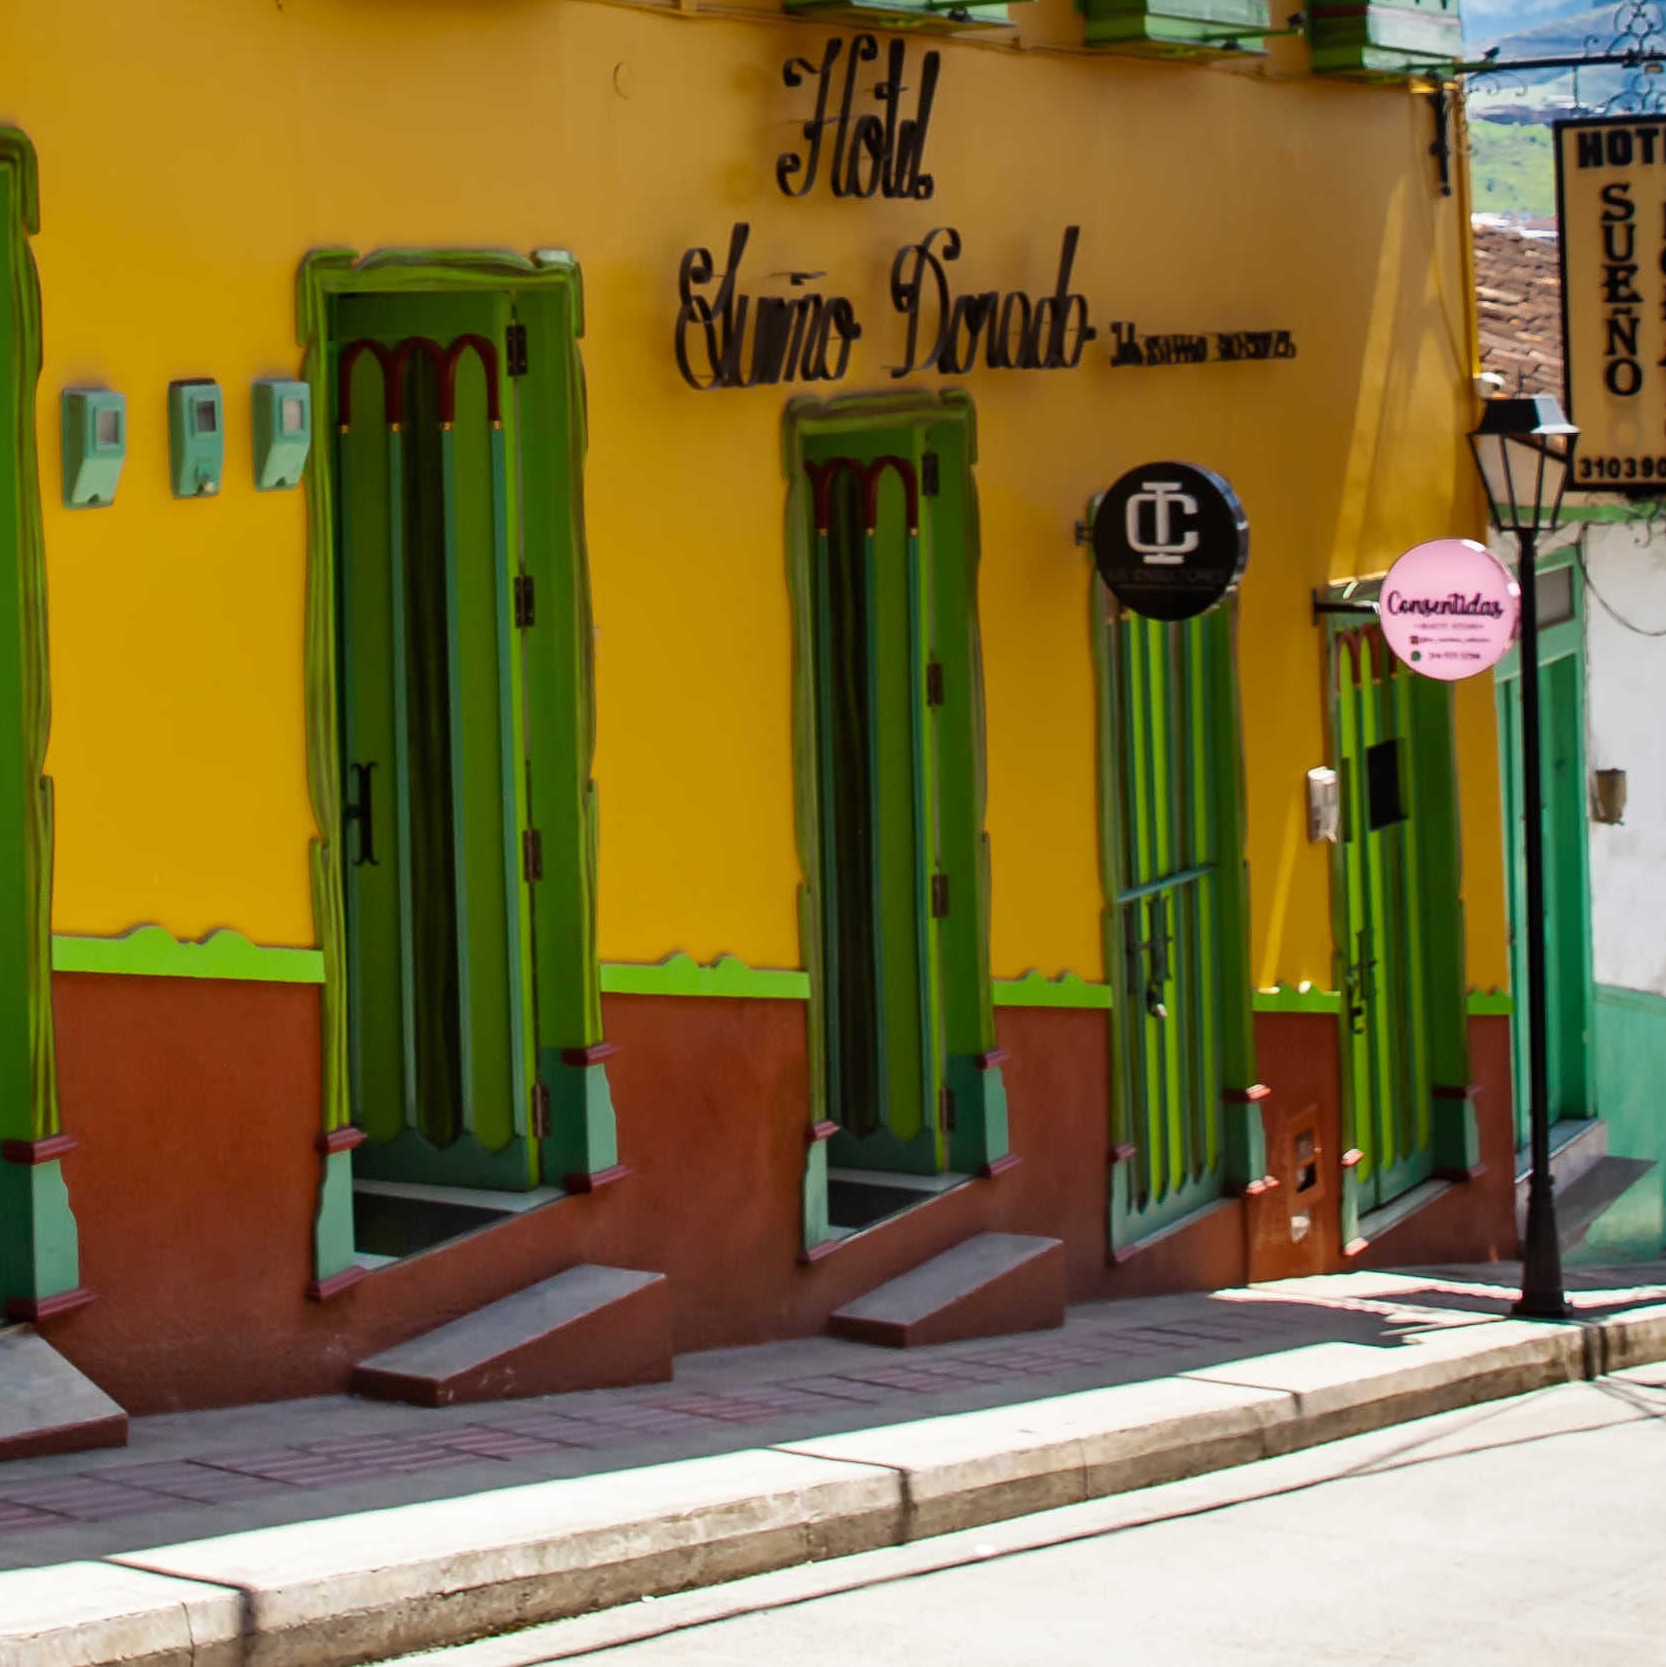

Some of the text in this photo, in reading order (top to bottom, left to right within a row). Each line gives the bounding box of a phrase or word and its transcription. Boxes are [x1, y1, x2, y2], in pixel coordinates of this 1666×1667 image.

[776, 35, 941, 200] Hotel
[675, 222, 1097, 391] Sueño Dorado
[1600, 182, 1644, 397] SUEÑO
[1387, 590, 1506, 620] Consentidas
